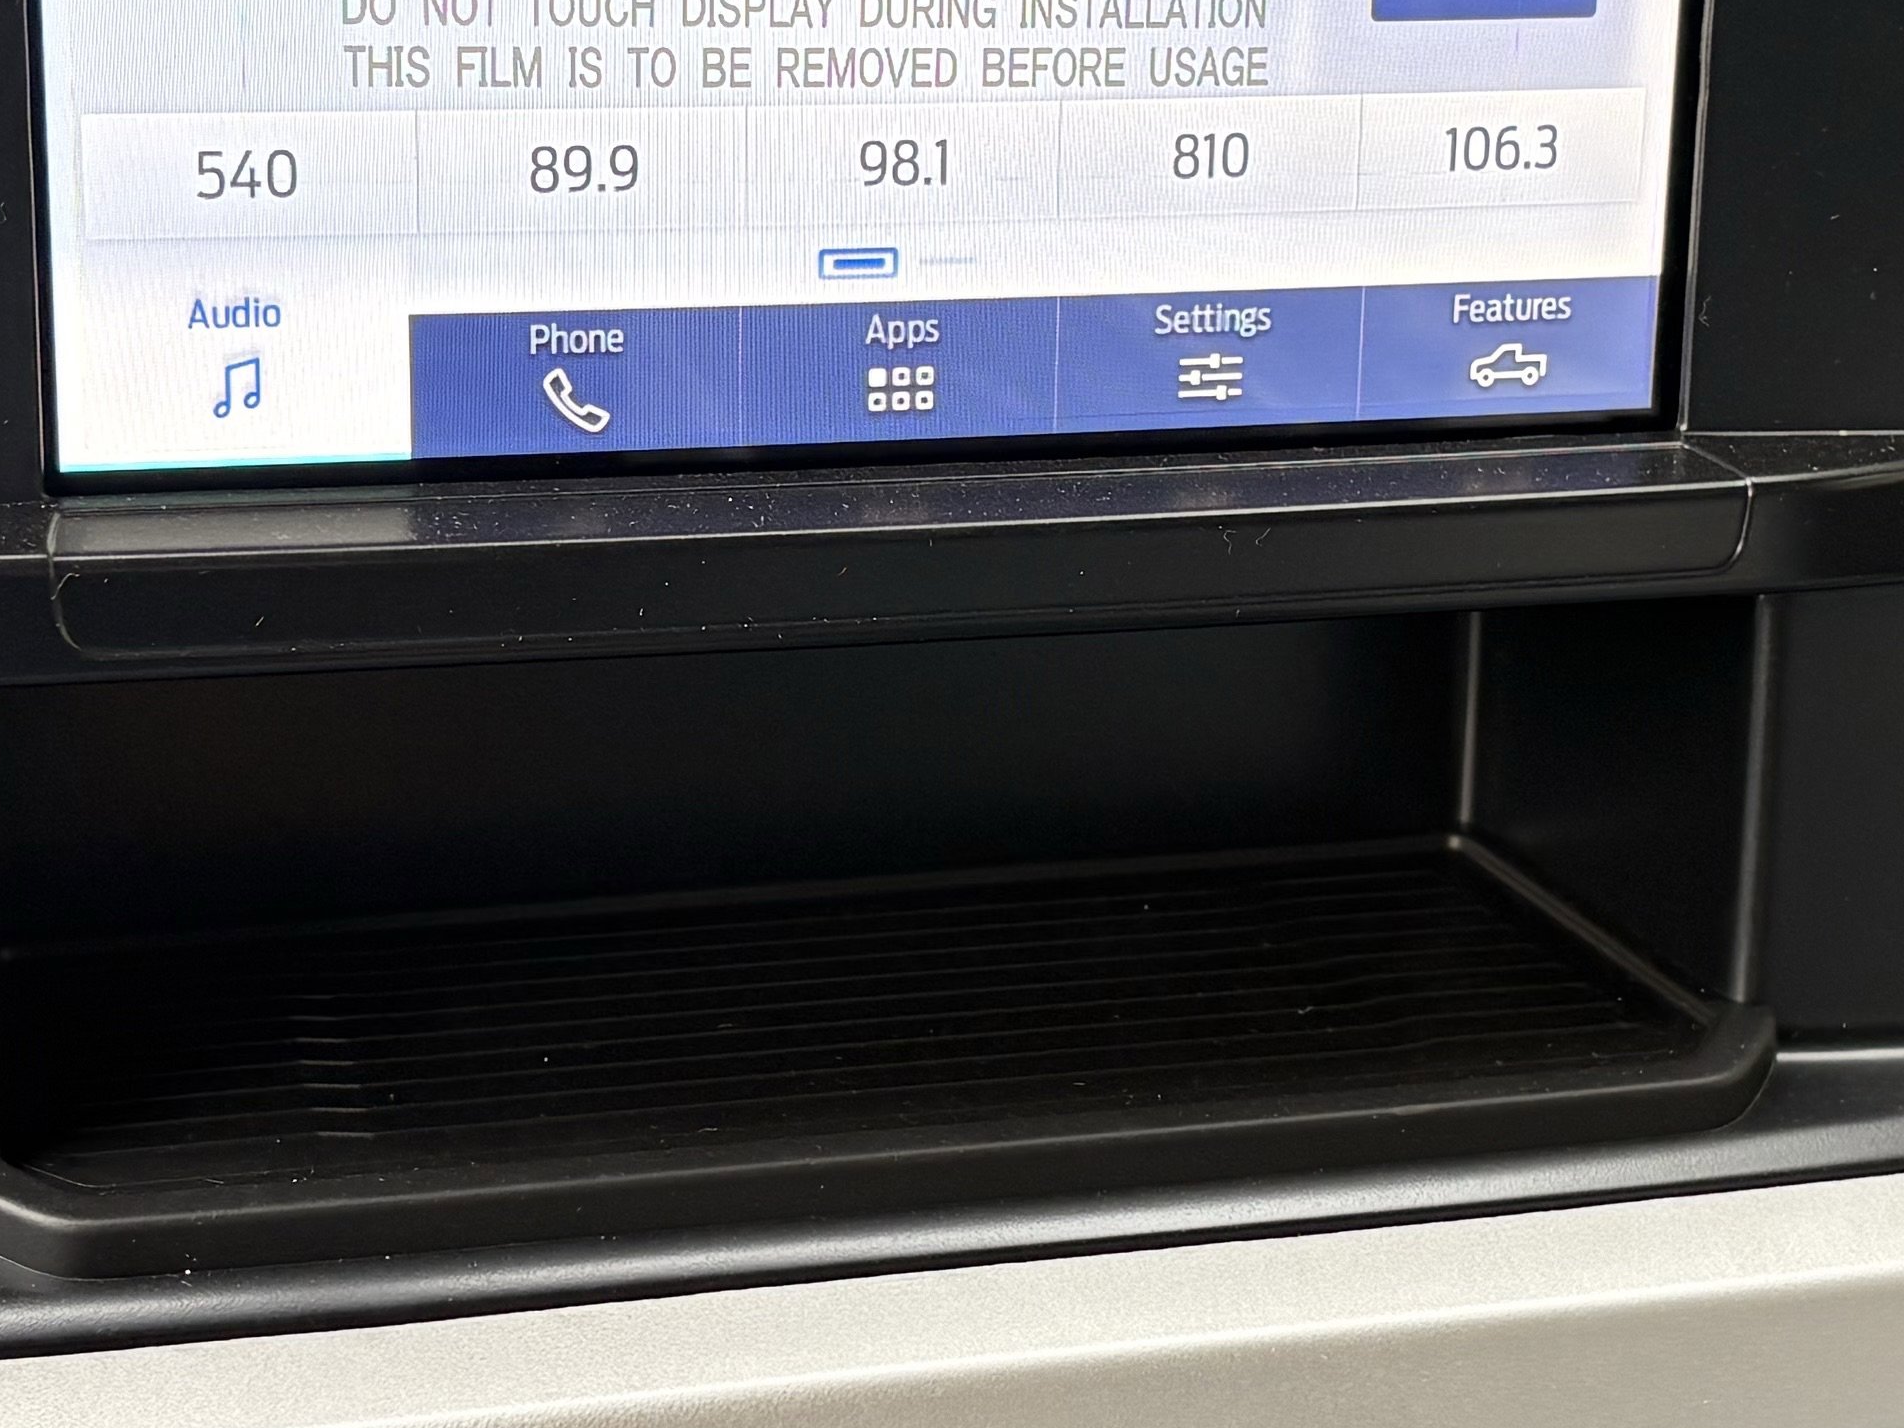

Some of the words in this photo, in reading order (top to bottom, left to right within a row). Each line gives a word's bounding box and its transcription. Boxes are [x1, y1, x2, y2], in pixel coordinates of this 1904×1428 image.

[343, 45, 431, 89] THIS
[456, 46, 543, 89] FILM
[568, 46, 603, 89] IS
[627, 46, 678, 89] TO
[702, 46, 753, 89] BE
[778, 46, 959, 89] REMOVED
[981, 46, 1127, 88] BEFORE
[1149, 46, 1270, 88] USAGE
[529, 143, 641, 194] 89.9
[858, 138, 951, 189] 98.1
[1172, 131, 1250, 180] 810
[1446, 123, 1559, 173] 106.3
[196, 148, 298, 200] 540
[187, 297, 283, 331] Audio
[1154, 300, 1272, 338] Settings
[1452, 290, 1572, 326] Features
[529, 322, 624, 356] Phone
[865, 313, 940, 349] Apps
